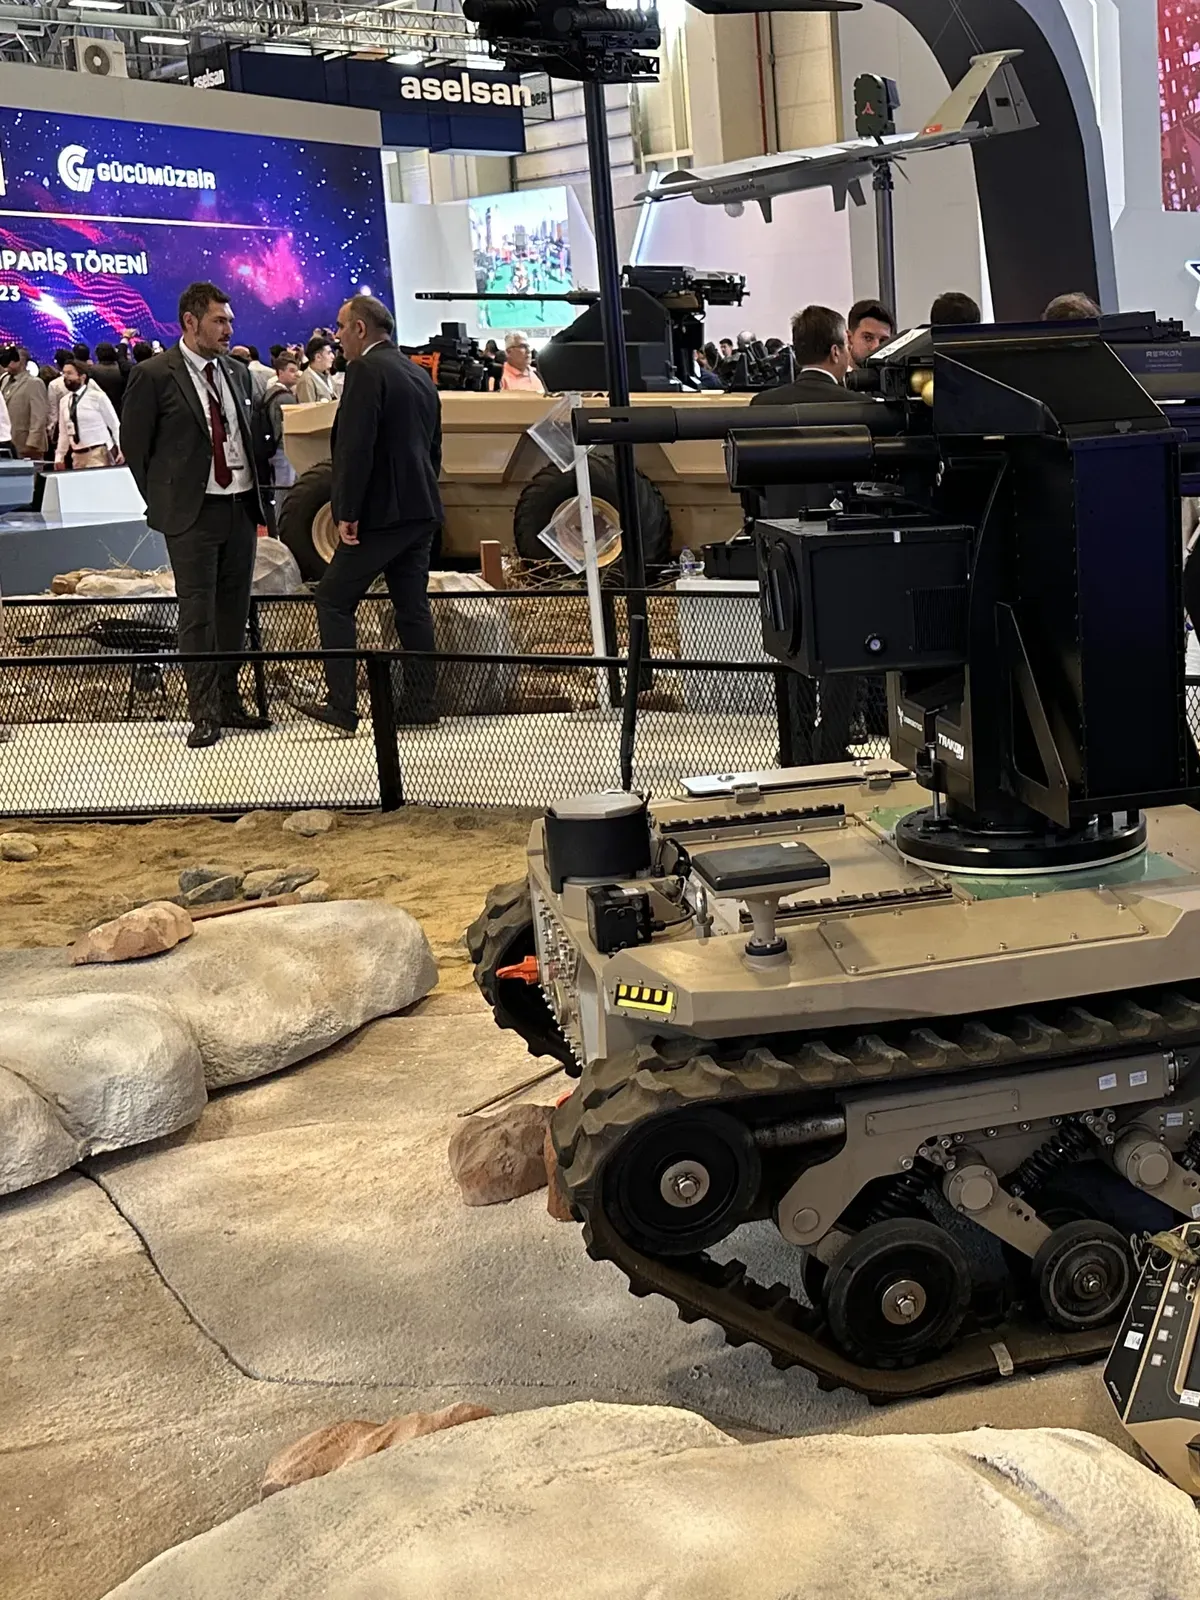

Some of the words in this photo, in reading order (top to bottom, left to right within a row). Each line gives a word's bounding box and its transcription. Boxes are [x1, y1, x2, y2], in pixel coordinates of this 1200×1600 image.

[401, 72, 532, 107] aselsan
[97, 161, 216, 190] GÜCÜMÜZBİR
[71, 249, 148, 275] TÖRENİ
